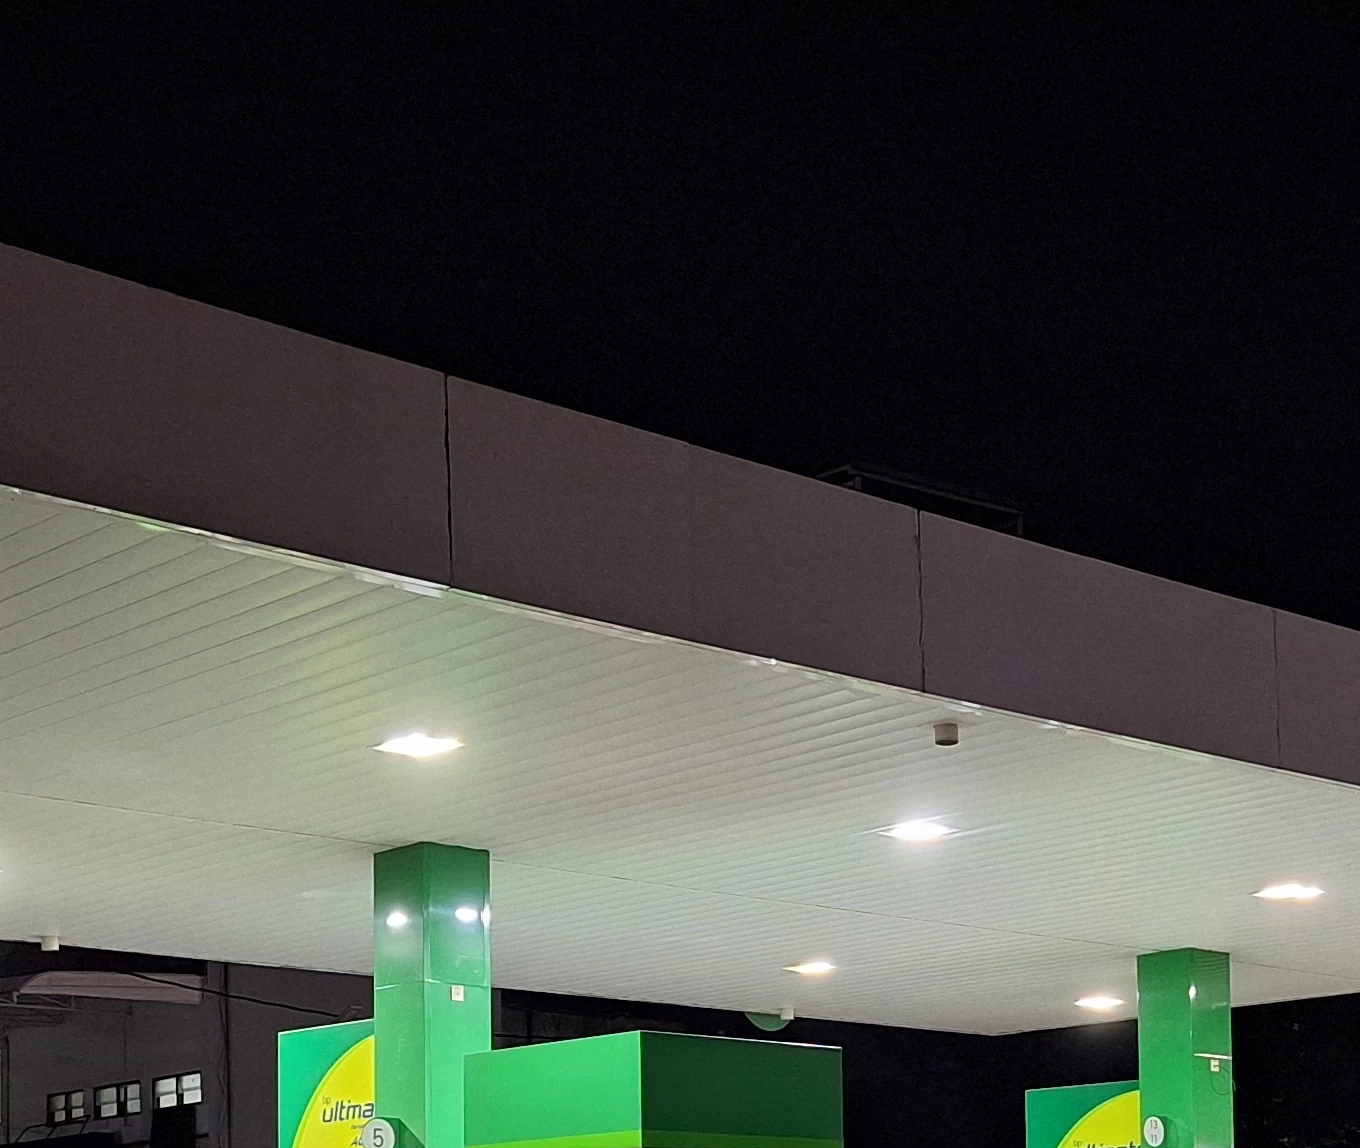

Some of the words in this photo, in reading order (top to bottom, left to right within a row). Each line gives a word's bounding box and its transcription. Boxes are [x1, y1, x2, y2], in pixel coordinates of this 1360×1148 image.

[322, 1099, 375, 1123] ultima
[1150, 1119, 1159, 1130] 13
[372, 1127, 385, 1148] 5
